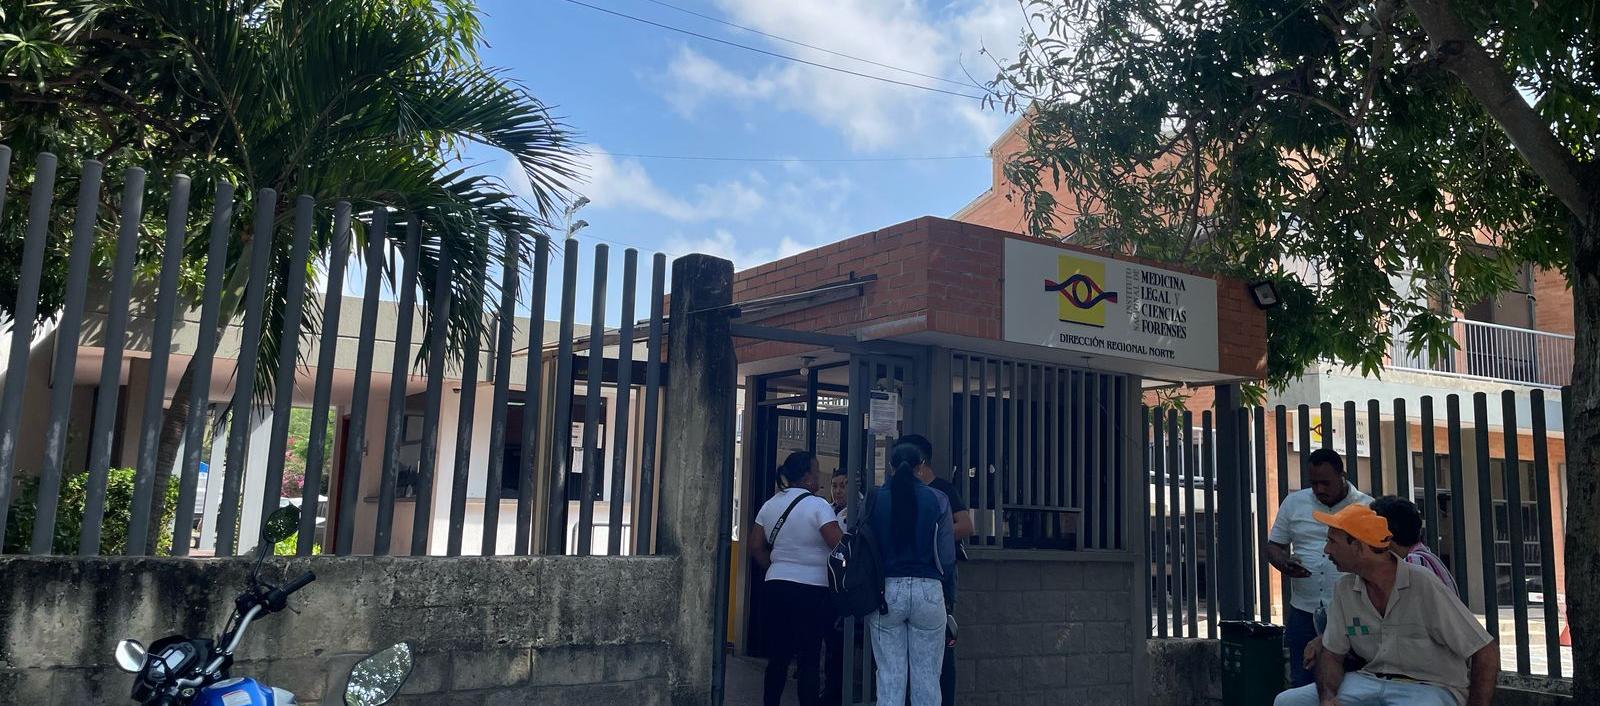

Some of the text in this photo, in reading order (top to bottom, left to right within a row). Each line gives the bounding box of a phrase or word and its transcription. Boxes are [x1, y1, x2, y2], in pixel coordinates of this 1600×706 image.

[1141, 270, 1186, 291] MEDICINA
[1141, 286, 1181, 306] LEGAL Y
[1141, 303, 1187, 323] CIENCIAS
[1141, 319, 1187, 339] FORENSES
[1059, 333, 1175, 359] DIRECCIÓN REGIONAL NORTE
